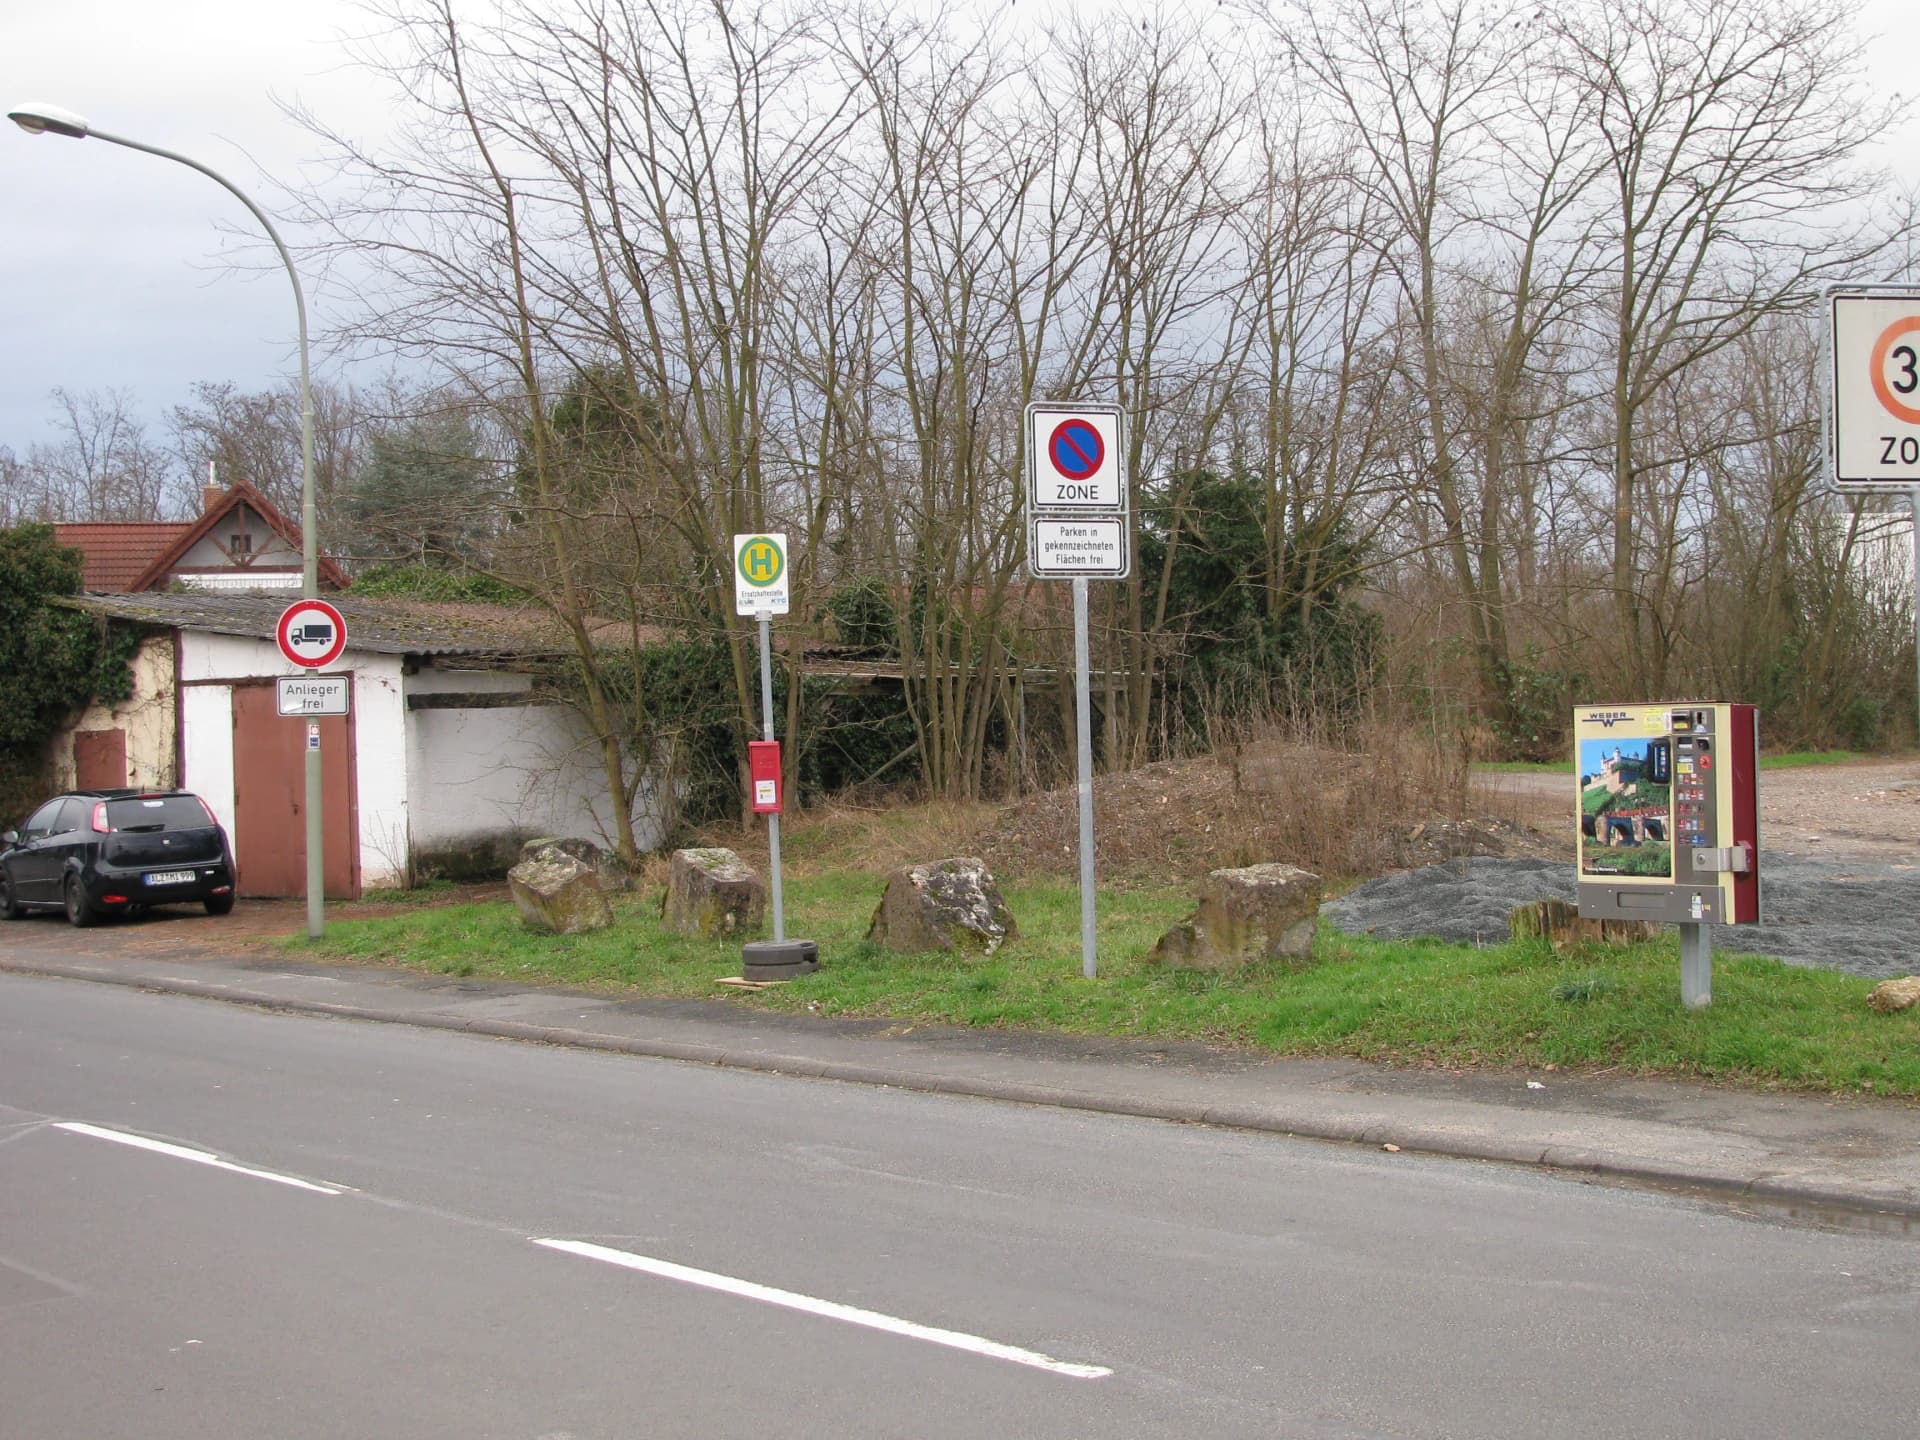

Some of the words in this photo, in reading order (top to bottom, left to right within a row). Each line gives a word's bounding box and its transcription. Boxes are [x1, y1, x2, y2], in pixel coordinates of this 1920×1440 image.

[1056, 484, 1099, 500] ZONE
[1060, 526, 1087, 537] Parken
[1090, 527, 1098, 537] in
[1044, 540, 1114, 553] gekennzeichneten
[751, 548, 772, 576] H
[1056, 553, 1087, 564] Flächen
[1090, 553, 1104, 564] frei
[286, 684, 340, 697] Anlieger
[303, 698, 324, 709] frei
[1590, 711, 1627, 719] WEBER
